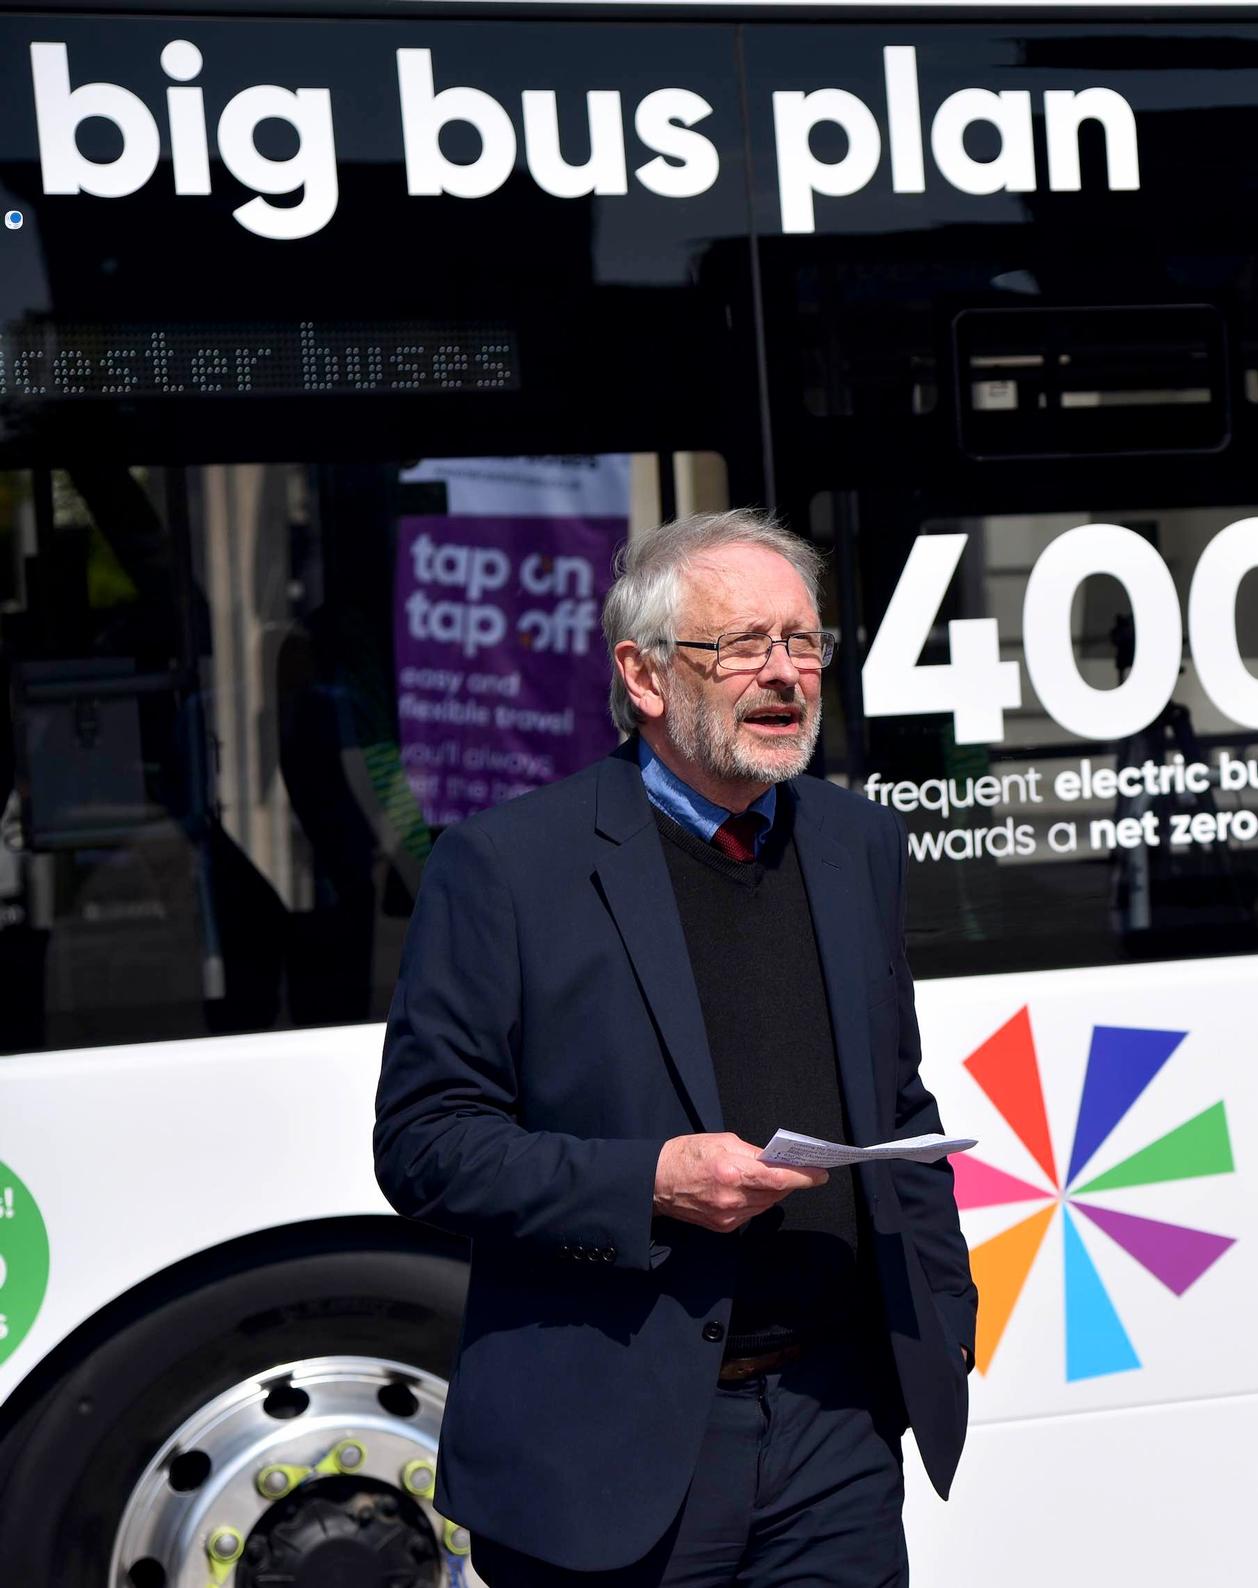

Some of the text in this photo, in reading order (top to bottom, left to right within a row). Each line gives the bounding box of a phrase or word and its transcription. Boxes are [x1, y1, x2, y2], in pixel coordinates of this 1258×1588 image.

[30, 40, 1140, 240] big bus plan
[300, 321, 511, 391] buses
[411, 533, 594, 600] tap on
[405, 589, 598, 659] tap off
[400, 667, 522, 698] easy and
[494, 707, 576, 736] travel
[863, 766, 1044, 819] frequent
[1054, 754, 1210, 802] electric
[908, 816, 1037, 863] wards
[1047, 822, 1078, 853] a
[1091, 811, 1160, 851] net
